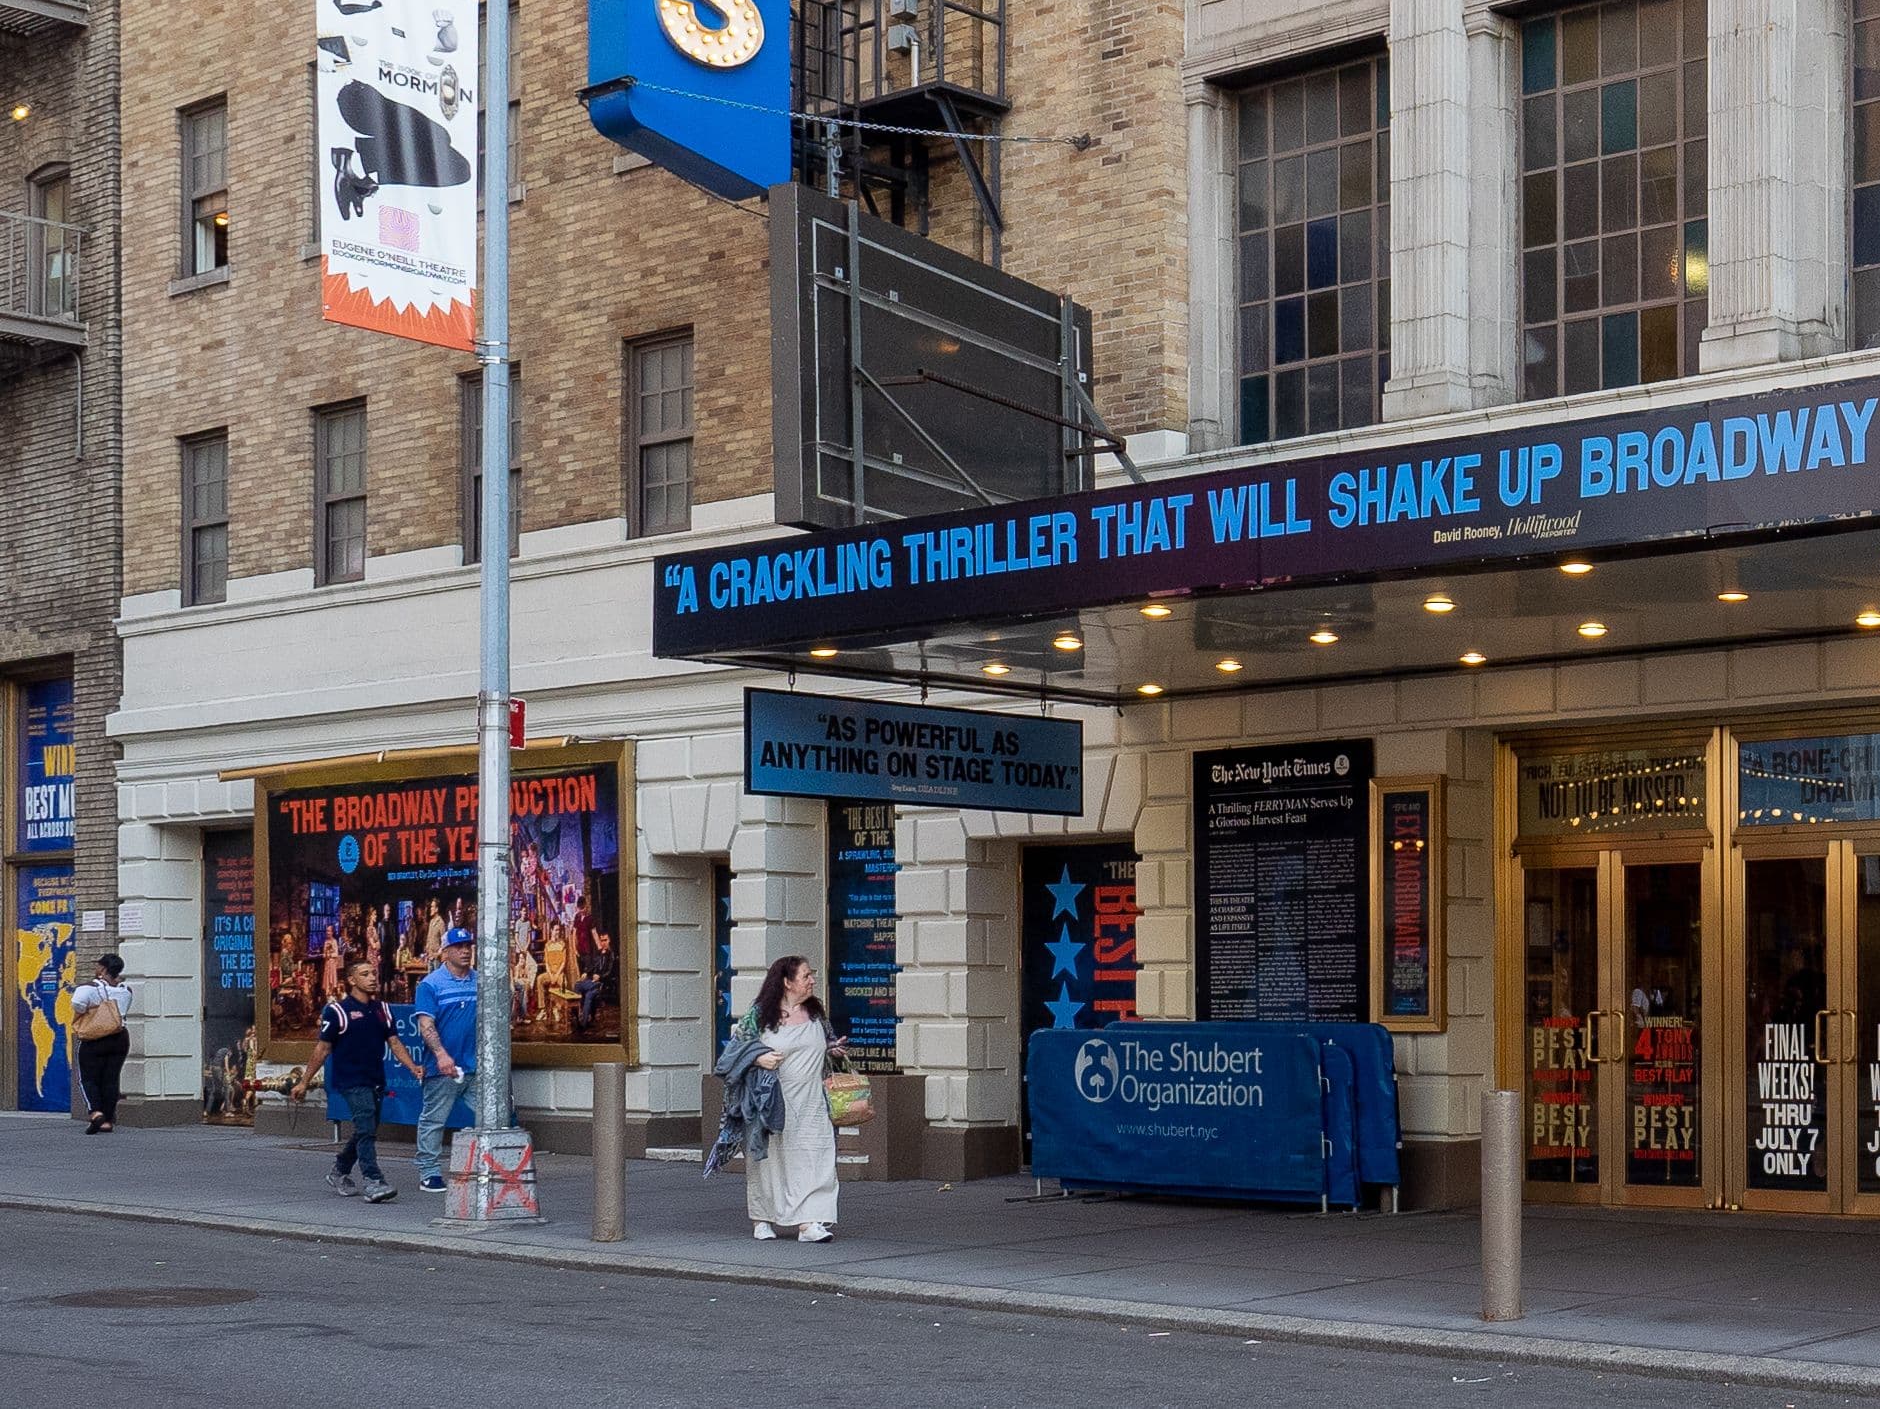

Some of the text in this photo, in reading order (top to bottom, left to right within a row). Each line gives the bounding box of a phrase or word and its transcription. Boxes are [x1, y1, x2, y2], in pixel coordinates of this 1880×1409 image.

[332, 239, 375, 257] EUGENE
[419, 260, 466, 277] THEATRE
[710, 538, 892, 609] CRACKLING
[902, 511, 1078, 584] THRILLER
[1091, 493, 1193, 559] THAT
[1207, 477, 1311, 544] WILL
[1328, 453, 1481, 529] SHAKE
[1499, 442, 1562, 507] UP
[1579, 397, 1879, 500] BROADWAY
[1433, 509, 1582, 544] David Rooney, Hollywood
[1540, 528, 1577, 538] REPORTER
[864, 718, 984, 753] POWERFUL
[991, 730, 1020, 756] AS
[760, 740, 878, 775] ANYTHING
[887, 751, 917, 778] ON
[925, 754, 994, 784] STAGE
[1212, 764, 1233, 784] The
[1235, 763, 1260, 782] New
[1262, 760, 1292, 784] York
[1294, 758, 1331, 776] Times
[25, 784, 56, 820] BEST
[280, 775, 596, 834] “THE BROADWAY PUCTION
[1208, 795, 1353, 815] A Thrilling FERRYMAN Serves Up
[1539, 778, 1618, 819] NOT TO BE
[865, 805, 886, 830] BEST
[1209, 813, 1307, 828] a Glorious Harvest Feast
[27, 821, 64, 839] ALL ACROSS
[854, 831, 889, 846] OF THE
[364, 827, 437, 867] OF THE
[1395, 814, 1420, 960] EXRAORDINARY.
[234, 916, 241, 931] A
[214, 935, 253, 950] ORIGINAL
[220, 954, 237, 969] THE
[222, 972, 252, 989] OF THE
[322, 1021, 330, 1032] 7
[1645, 1016, 1683, 1028] WINNER!
[1533, 1027, 1588, 1049] BEST
[1635, 1029, 1653, 1060] 4
[1655, 1029, 1693, 1043] TONY
[1765, 1023, 1809, 1061] FINAL
[1120, 1042, 1263, 1075] The Shubert
[1533, 1048, 1588, 1069] PLAY
[1634, 1069, 1693, 1083] BEST PLAY
[1758, 1062, 1815, 1100] WEEKS!
[1120, 1074, 1263, 1111] Organization
[1533, 1104, 1590, 1126] BEST
[1634, 1106, 1693, 1127] BEST
[1762, 1103, 1812, 1126] THRU
[1117, 1122, 1218, 1139] www.shubert.nyc
[1533, 1125, 1590, 1147] PLAY
[1634, 1127, 1693, 1150] PLAY
[1755, 1128, 1819, 1151] JULY 7
[1763, 1152, 1811, 1175] ONLY
